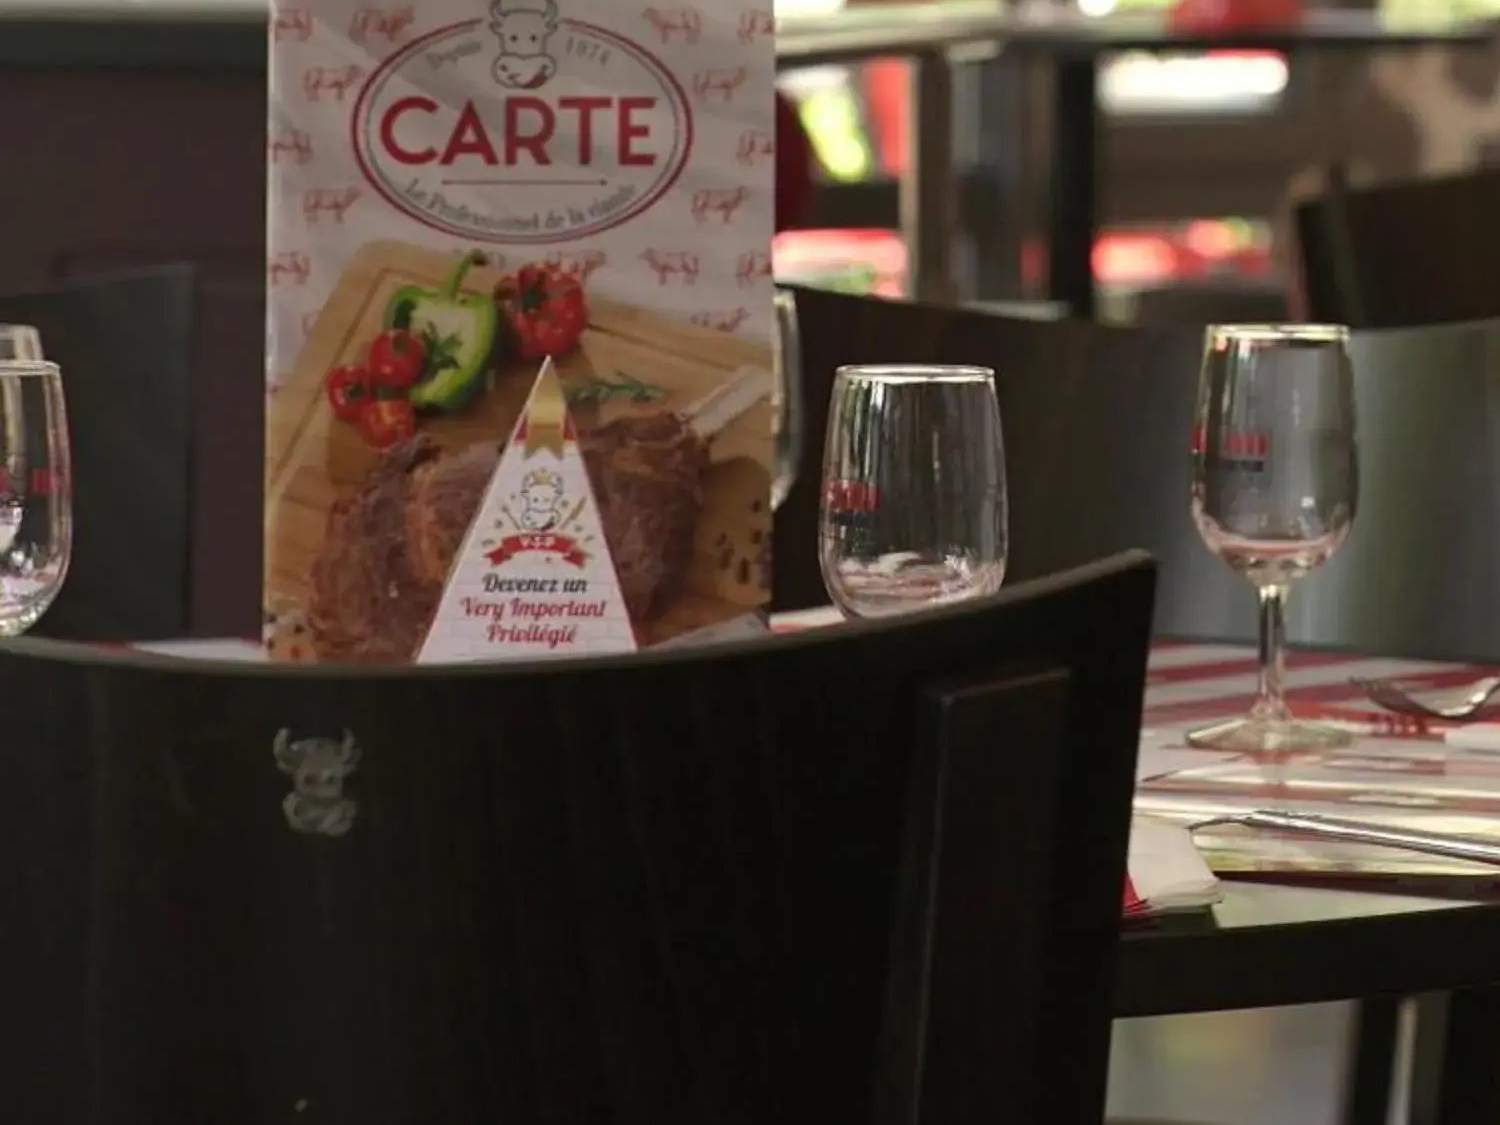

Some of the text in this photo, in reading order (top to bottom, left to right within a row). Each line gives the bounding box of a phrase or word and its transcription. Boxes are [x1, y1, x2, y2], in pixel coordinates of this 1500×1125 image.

[380, 96, 657, 166] CARTE
[545, 210, 566, 230] de
[567, 206, 586, 225] la
[482, 573, 587, 593] Devenez un
[460, 597, 607, 623] Very Important
[486, 623, 578, 649] Privilégié
